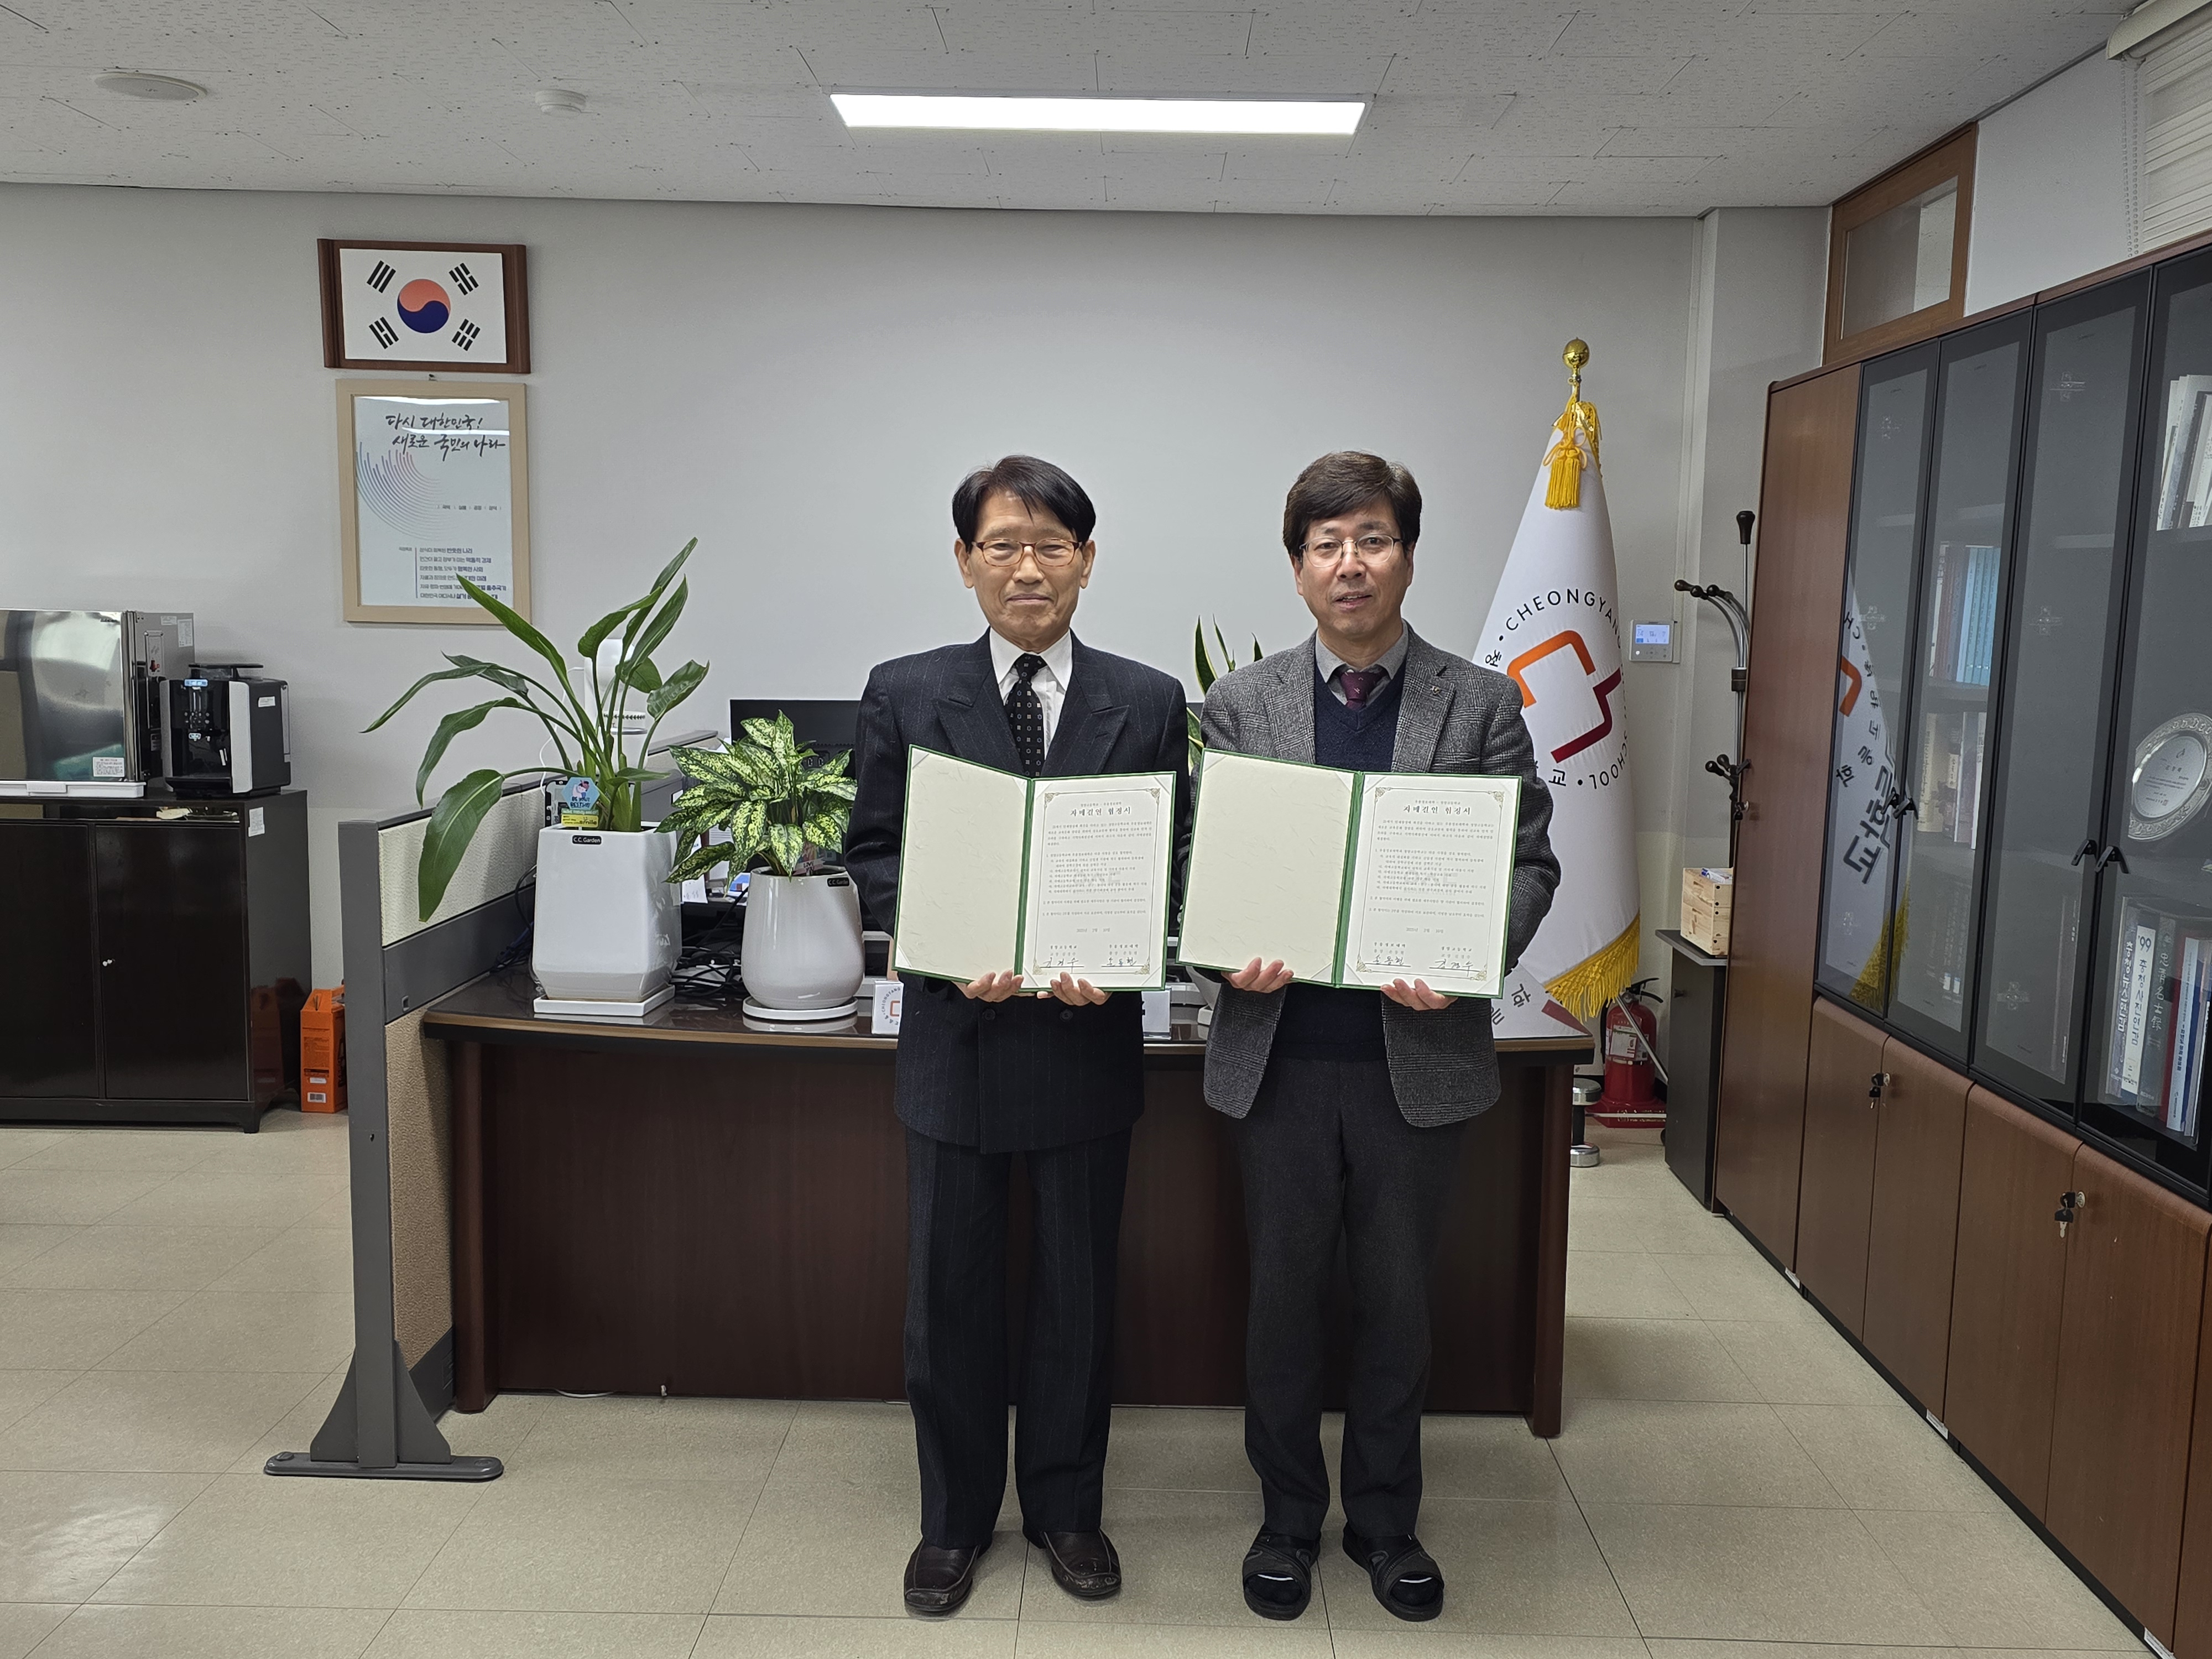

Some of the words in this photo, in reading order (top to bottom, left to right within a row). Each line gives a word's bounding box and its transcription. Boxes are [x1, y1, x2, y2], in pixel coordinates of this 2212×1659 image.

[385, 413, 415, 430] 다시
[420, 412, 483, 430] 대한민국!
[392, 433, 430, 455] 새로운
[434, 434, 470, 462] 국민의
[473, 435, 506, 457] 나라
[2138, 935, 2152, 952] '99
[2131, 959, 2147, 1046] 충청사진연감
